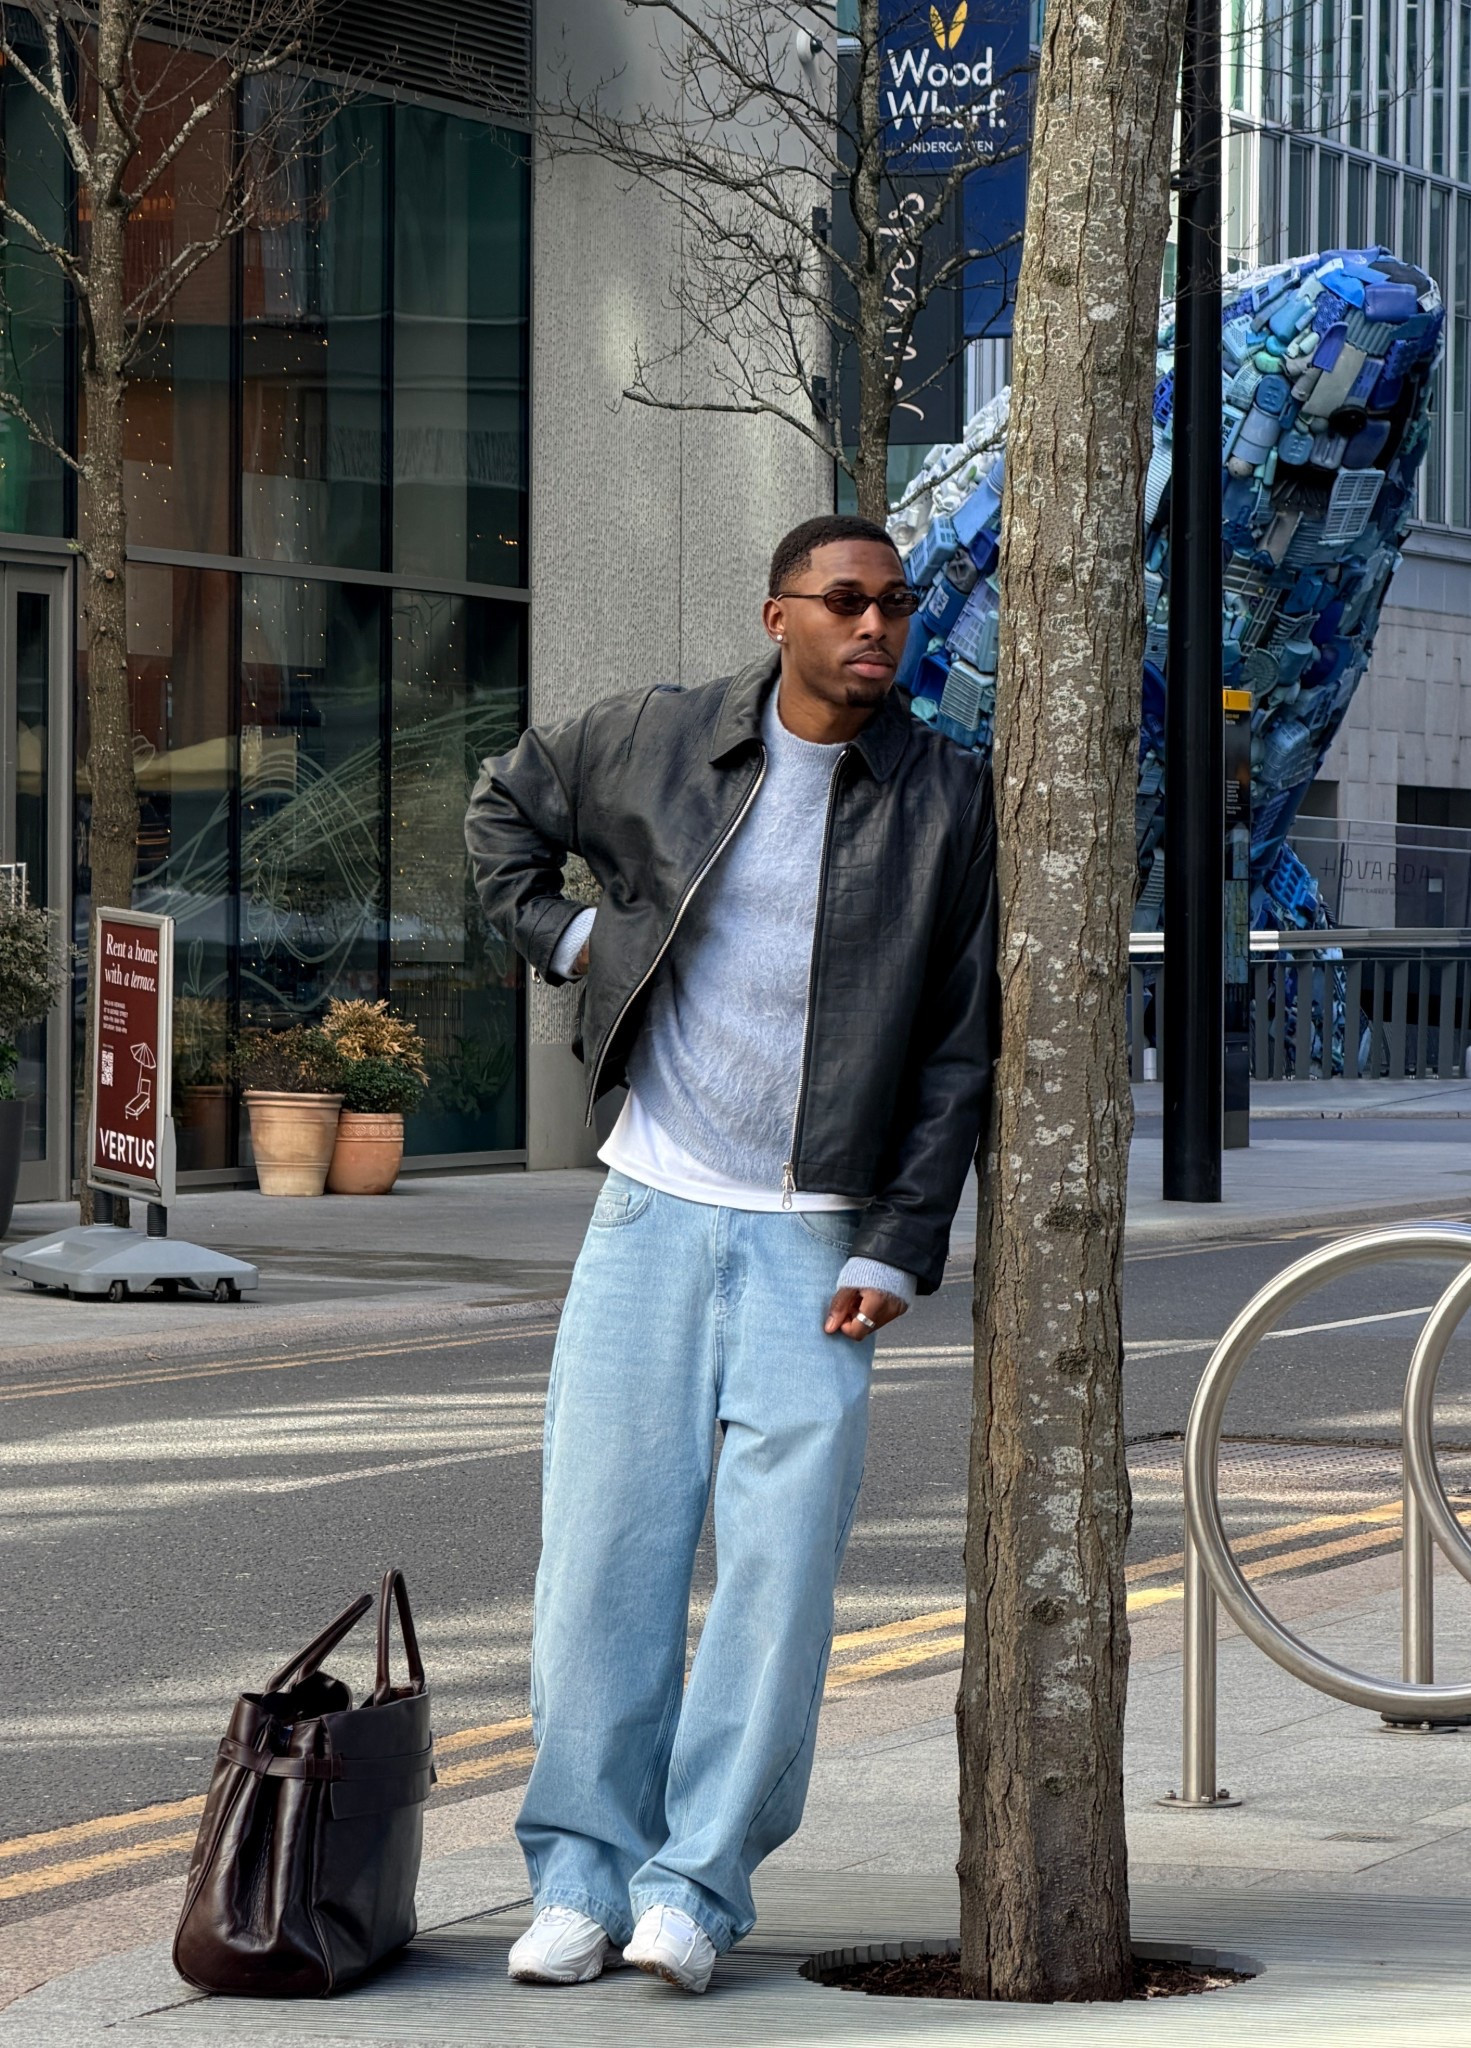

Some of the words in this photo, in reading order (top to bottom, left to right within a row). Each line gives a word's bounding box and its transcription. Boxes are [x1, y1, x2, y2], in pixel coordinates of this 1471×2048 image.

[887, 46, 993, 88] Wood
[106, 933, 126, 958] Rent
[127, 945, 133, 960] a
[134, 939, 158, 965] home
[104, 962, 122, 985] with
[123, 972, 130, 987] a
[131, 970, 156, 992] terrace.
[99, 1127, 155, 1170] VERTUS
